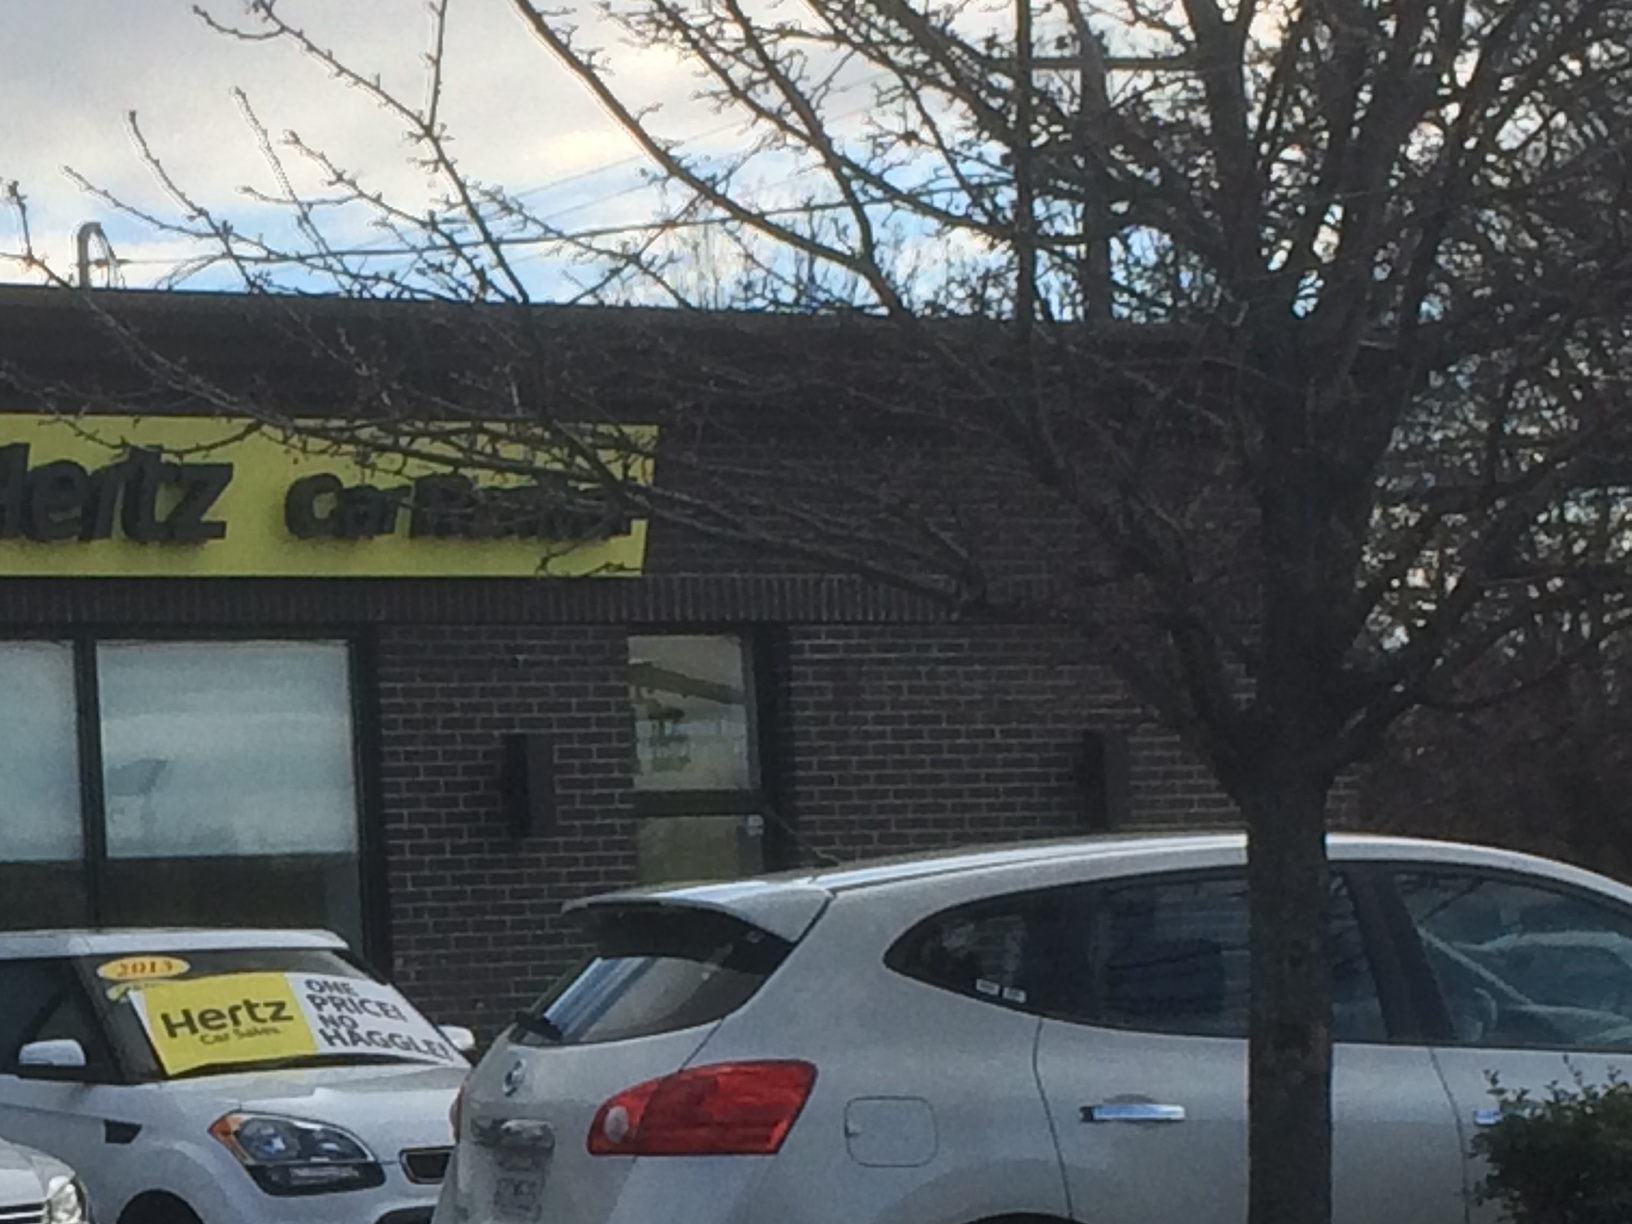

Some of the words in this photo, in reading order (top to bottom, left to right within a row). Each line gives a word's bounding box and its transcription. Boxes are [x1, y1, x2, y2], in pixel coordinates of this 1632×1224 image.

[285, 472, 413, 539] Car
[304, 979, 359, 997] ONE
[160, 998, 295, 1039] Hertz
[318, 1014, 359, 1030] NO
[199, 1032, 231, 1045] Car
